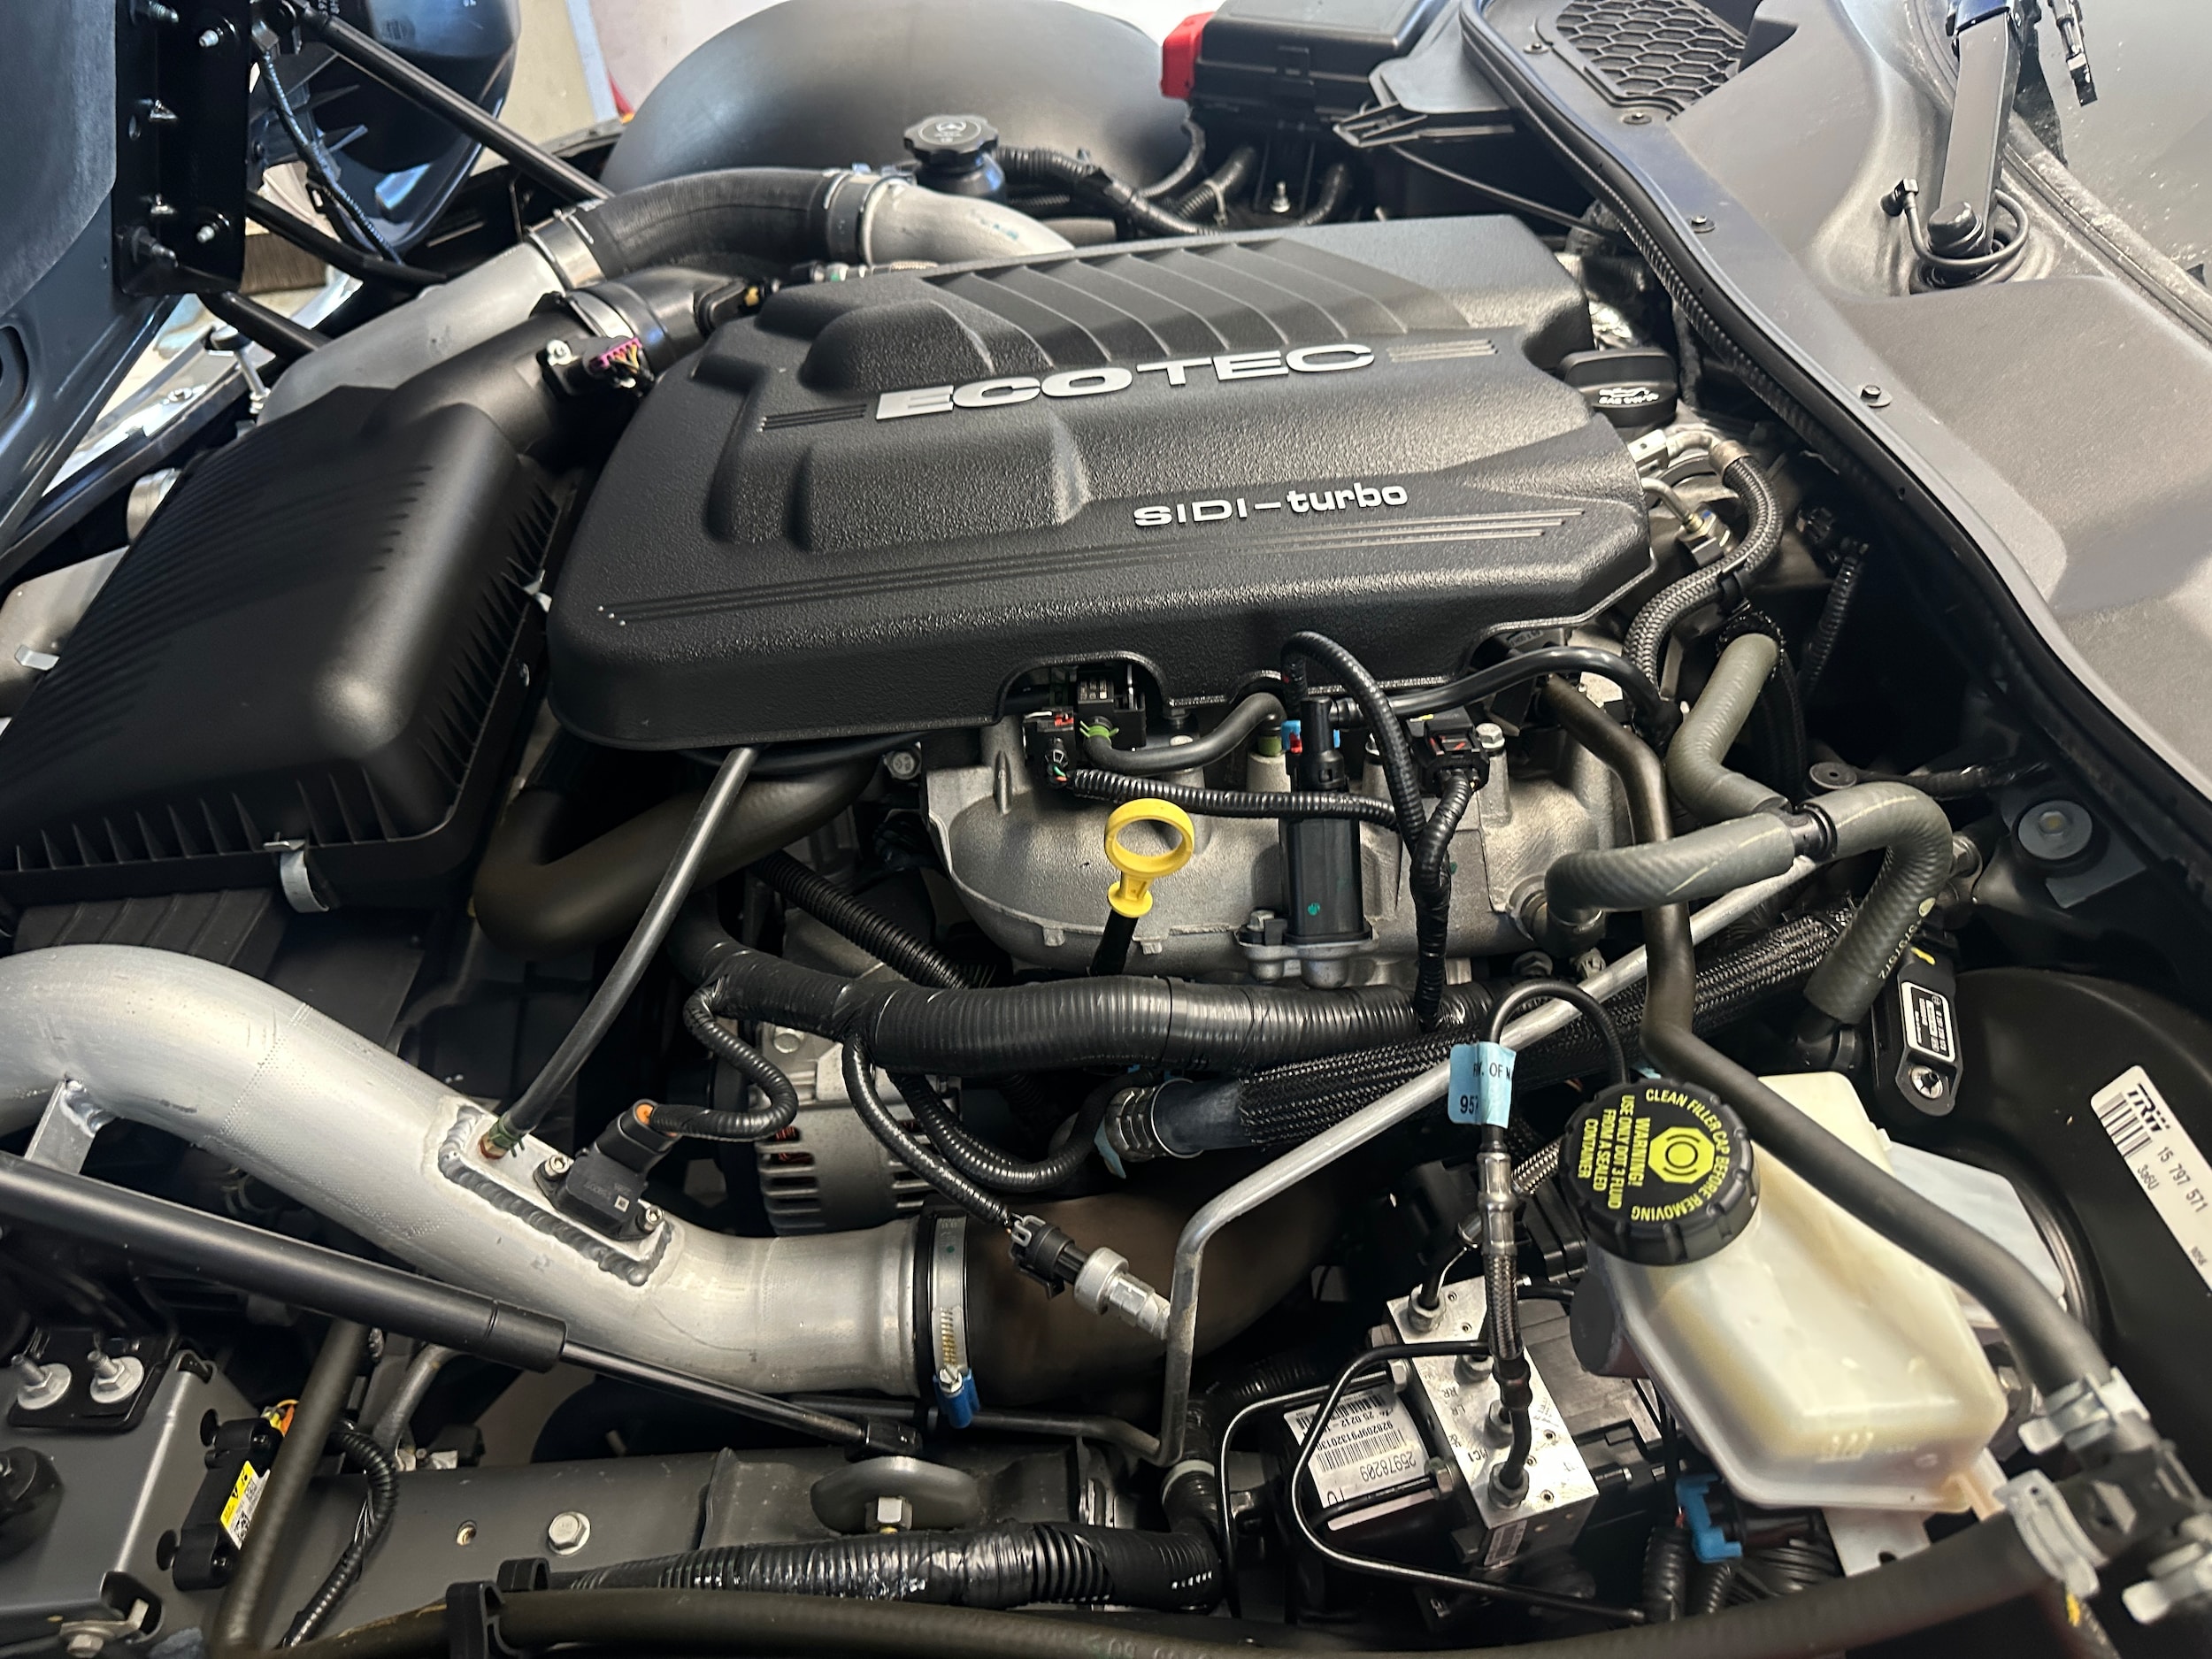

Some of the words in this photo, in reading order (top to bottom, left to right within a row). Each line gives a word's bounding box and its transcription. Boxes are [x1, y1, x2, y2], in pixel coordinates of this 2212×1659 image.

[876, 343, 1374, 419] ECOTEC
[1134, 482, 1408, 526] SIDI-turbo
[1489, 1063, 1502, 1078] OF
[1621, 1095, 1634, 1115] USE
[1647, 1089, 1686, 1106] CLEAN
[2128, 1083, 2170, 1132] TRW
[1601, 1110, 1616, 1140] FROM
[1617, 1117, 1632, 1145] ONLY
[1688, 1101, 1722, 1132] FILLER
[1578, 1119, 1598, 1178] CONTAINER
[1599, 1140, 1612, 1149] A
[1615, 1145, 1628, 1167] DOT
[1628, 1118, 1650, 1186] WARNING!
[1713, 1131, 1730, 1155] CAP
[1594, 1151, 1610, 1191] SEALED
[1699, 1156, 1730, 1198] BEFORE
[2158, 1147, 2173, 1162] 15
[2170, 1164, 2191, 1185] 797
[2186, 1188, 2208, 1212] 571
[1609, 1177, 1624, 1209] FLUID
[1632, 1194, 1702, 1220] REMOVING
[1360, 1452, 1416, 1481] 25978209
